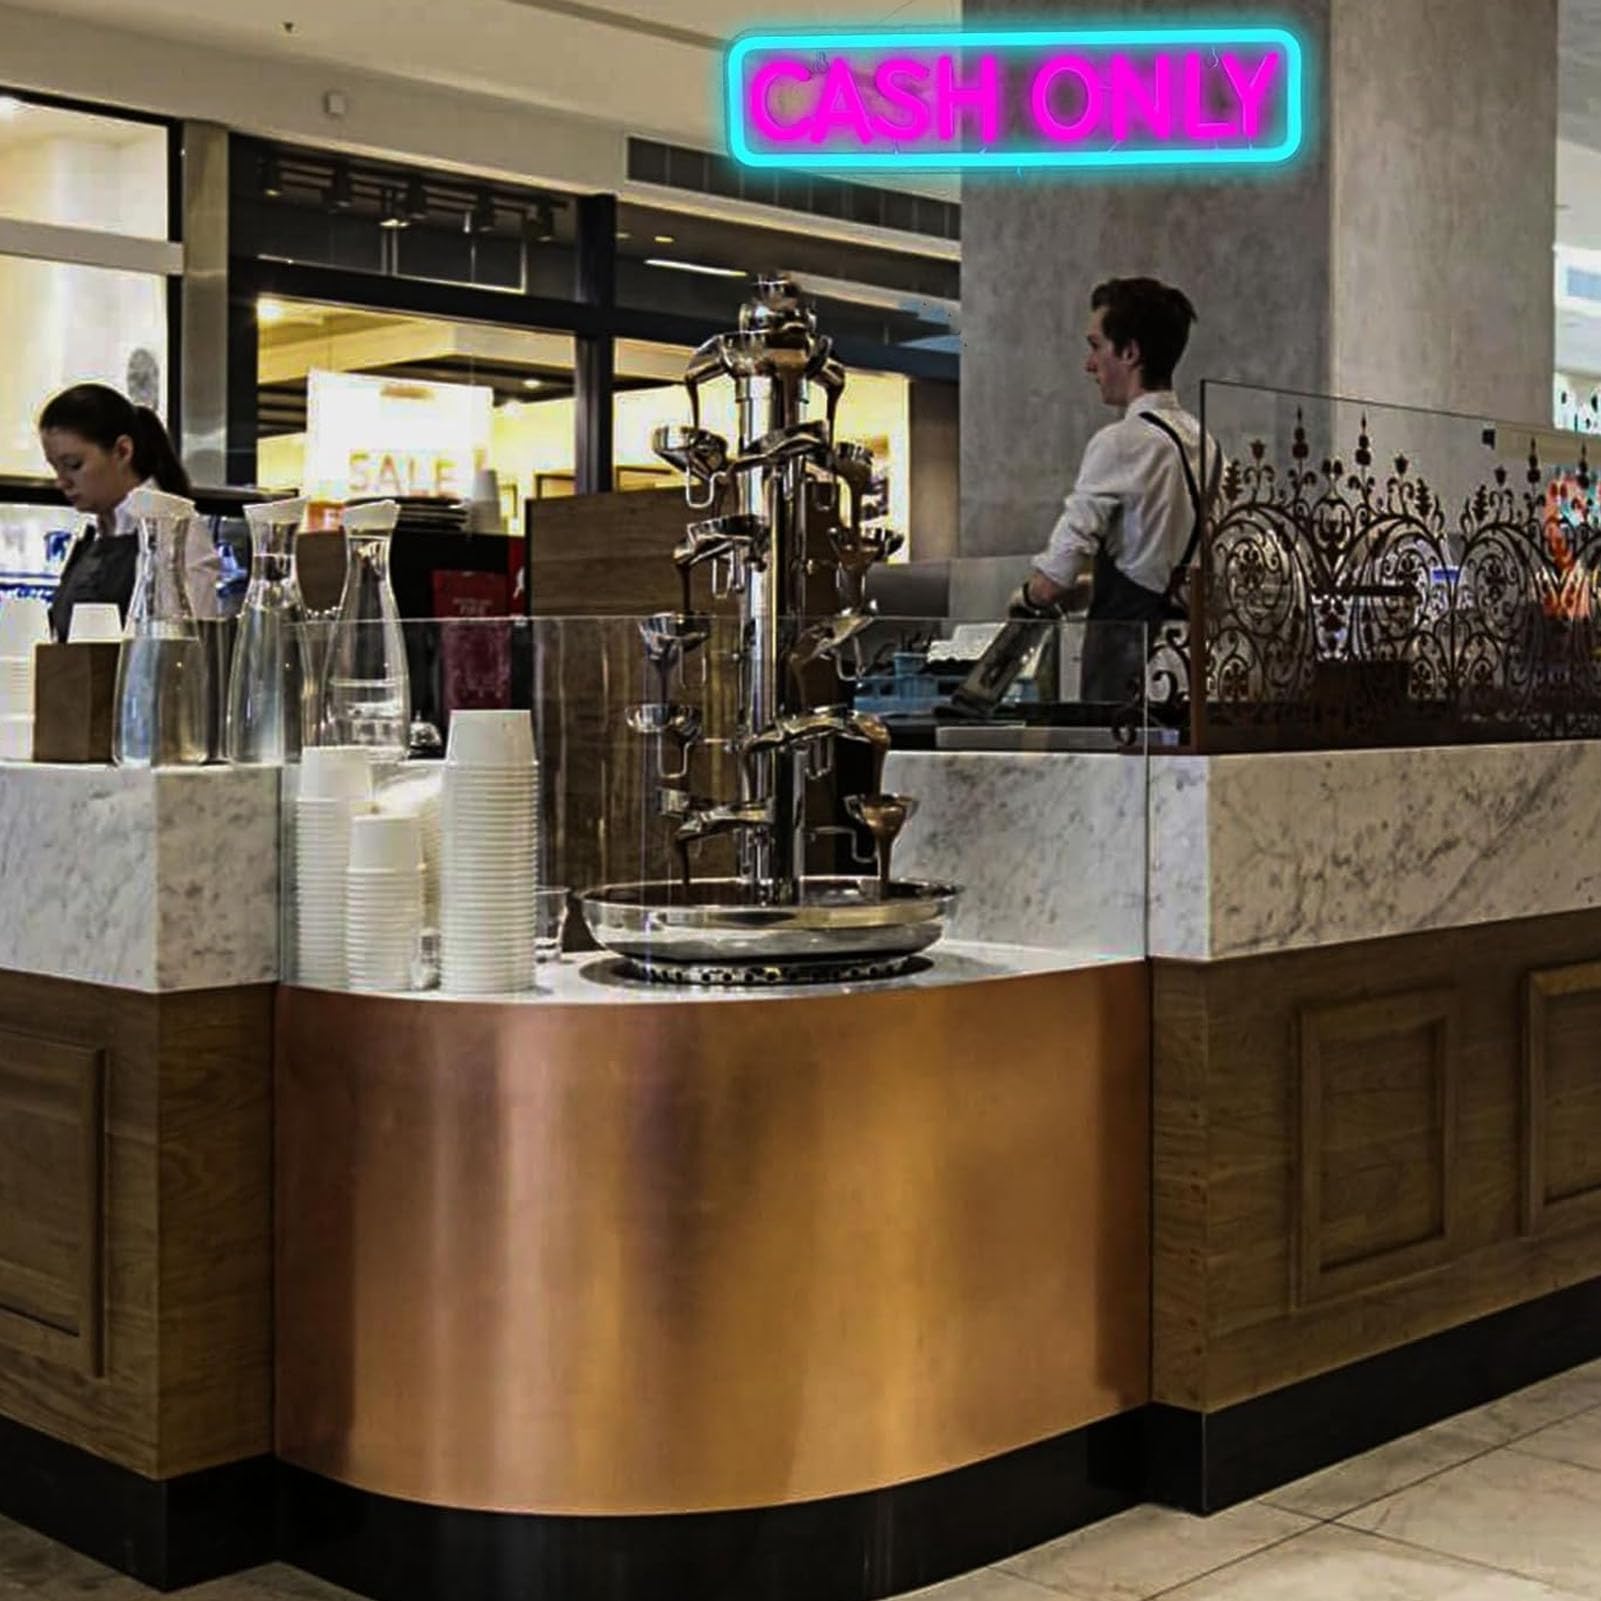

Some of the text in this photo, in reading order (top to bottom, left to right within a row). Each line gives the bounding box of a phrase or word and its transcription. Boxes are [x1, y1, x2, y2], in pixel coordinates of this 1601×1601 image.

[749, 52, 1278, 143] CASH ONLY
[349, 451, 457, 498] SALE
